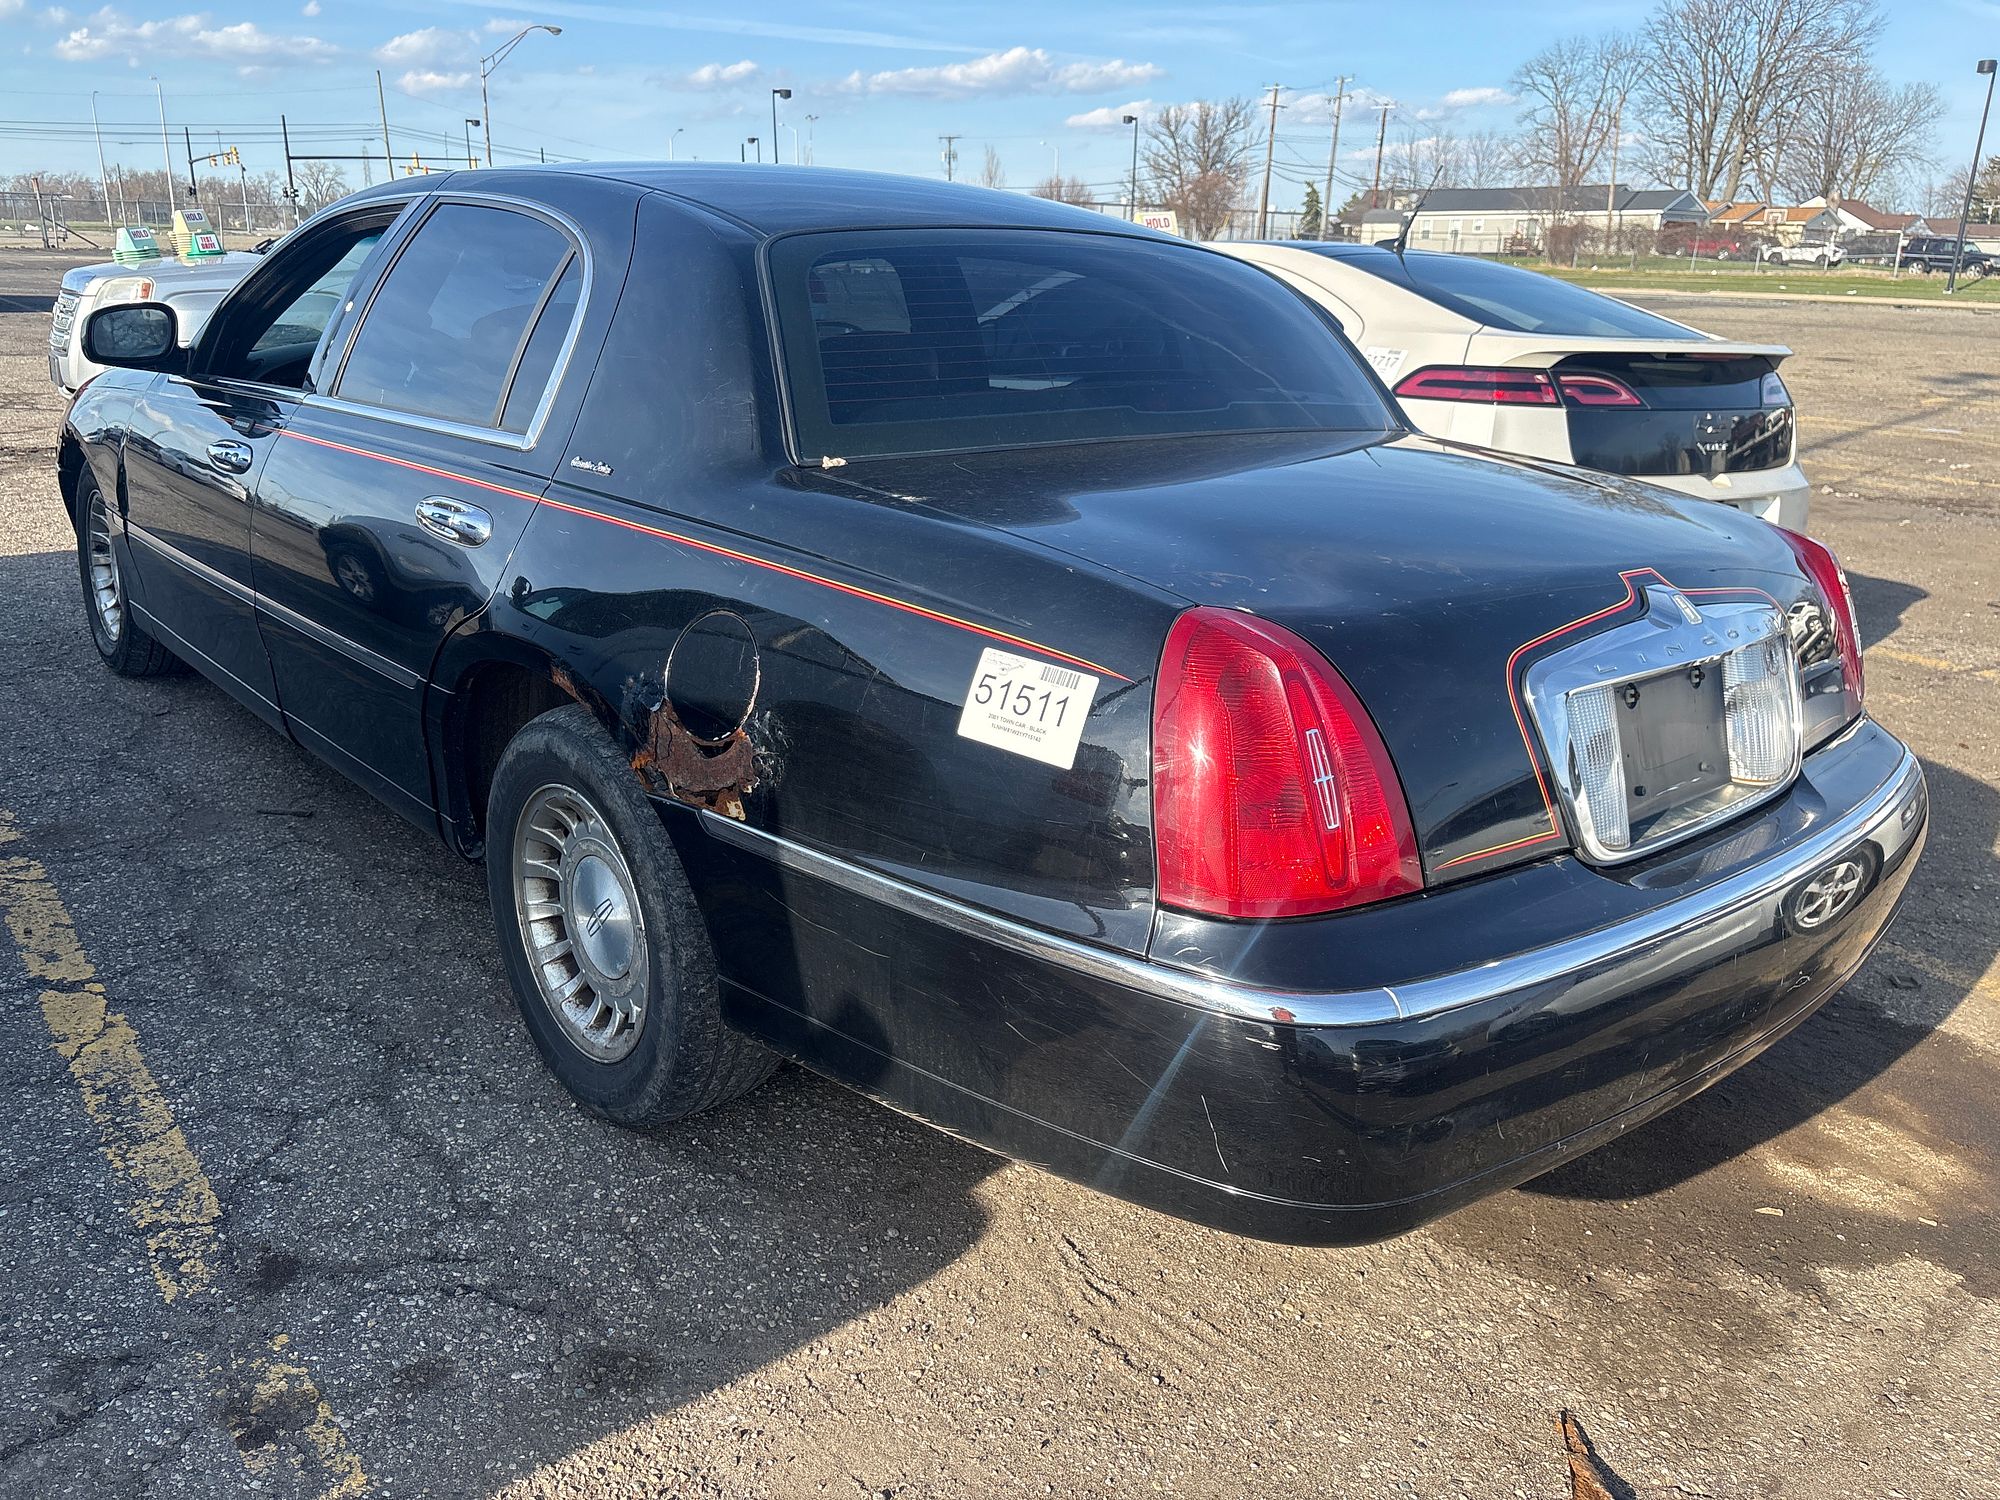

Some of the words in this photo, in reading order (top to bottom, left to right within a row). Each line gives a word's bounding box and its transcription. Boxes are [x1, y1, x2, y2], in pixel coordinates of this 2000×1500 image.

[184, 212, 203, 221] HOLD
[1145, 217, 1170, 229] HOLD
[131, 229, 149, 239] HOLD
[975, 673, 1069, 727] 51511
[1000, 716, 1014, 726] TOWN
[1014, 720, 1027, 729] CAR
[1029, 725, 1047, 736] BLACK
